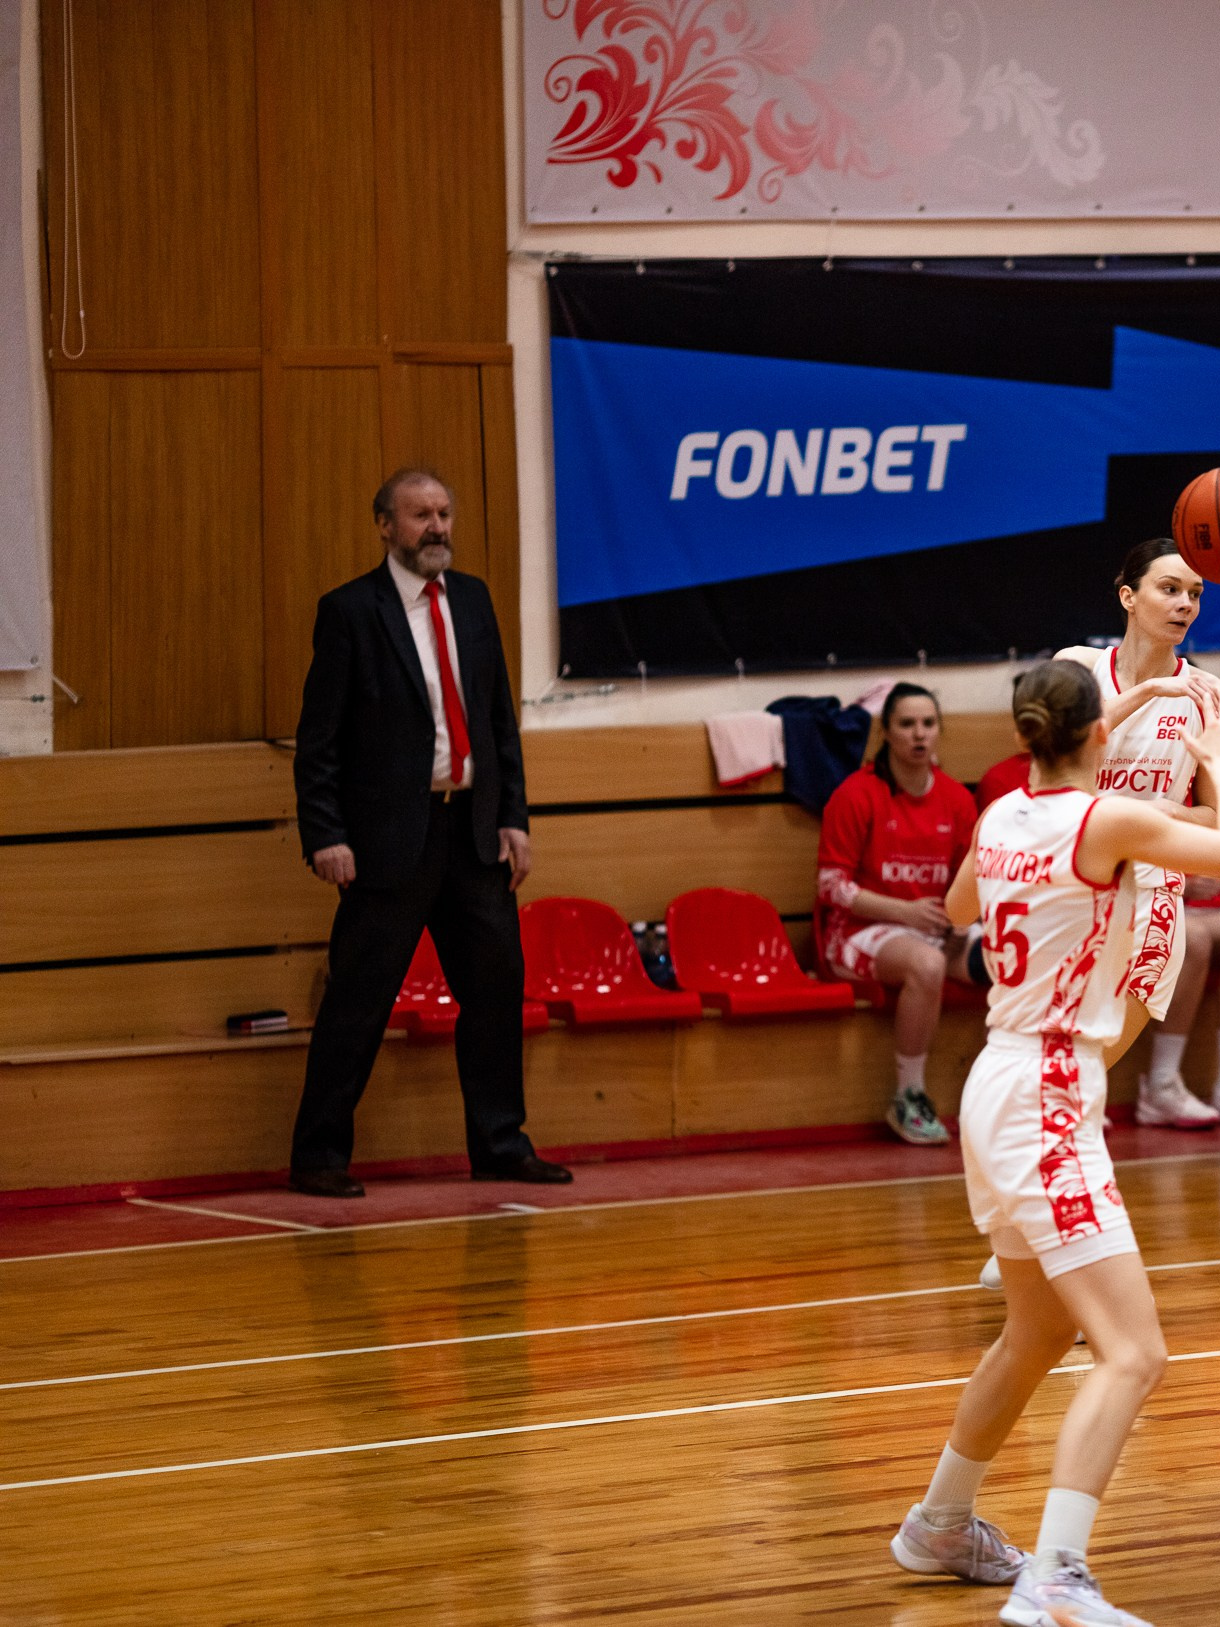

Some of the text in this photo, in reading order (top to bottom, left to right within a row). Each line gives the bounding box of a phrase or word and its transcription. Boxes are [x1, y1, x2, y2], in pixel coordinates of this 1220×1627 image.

[670, 424, 966, 500] FONBET
[1157, 716, 1188, 727] FON
[1151, 758, 1172, 766] КЛУБ
[1096, 769, 1173, 793] НОСТЬ
